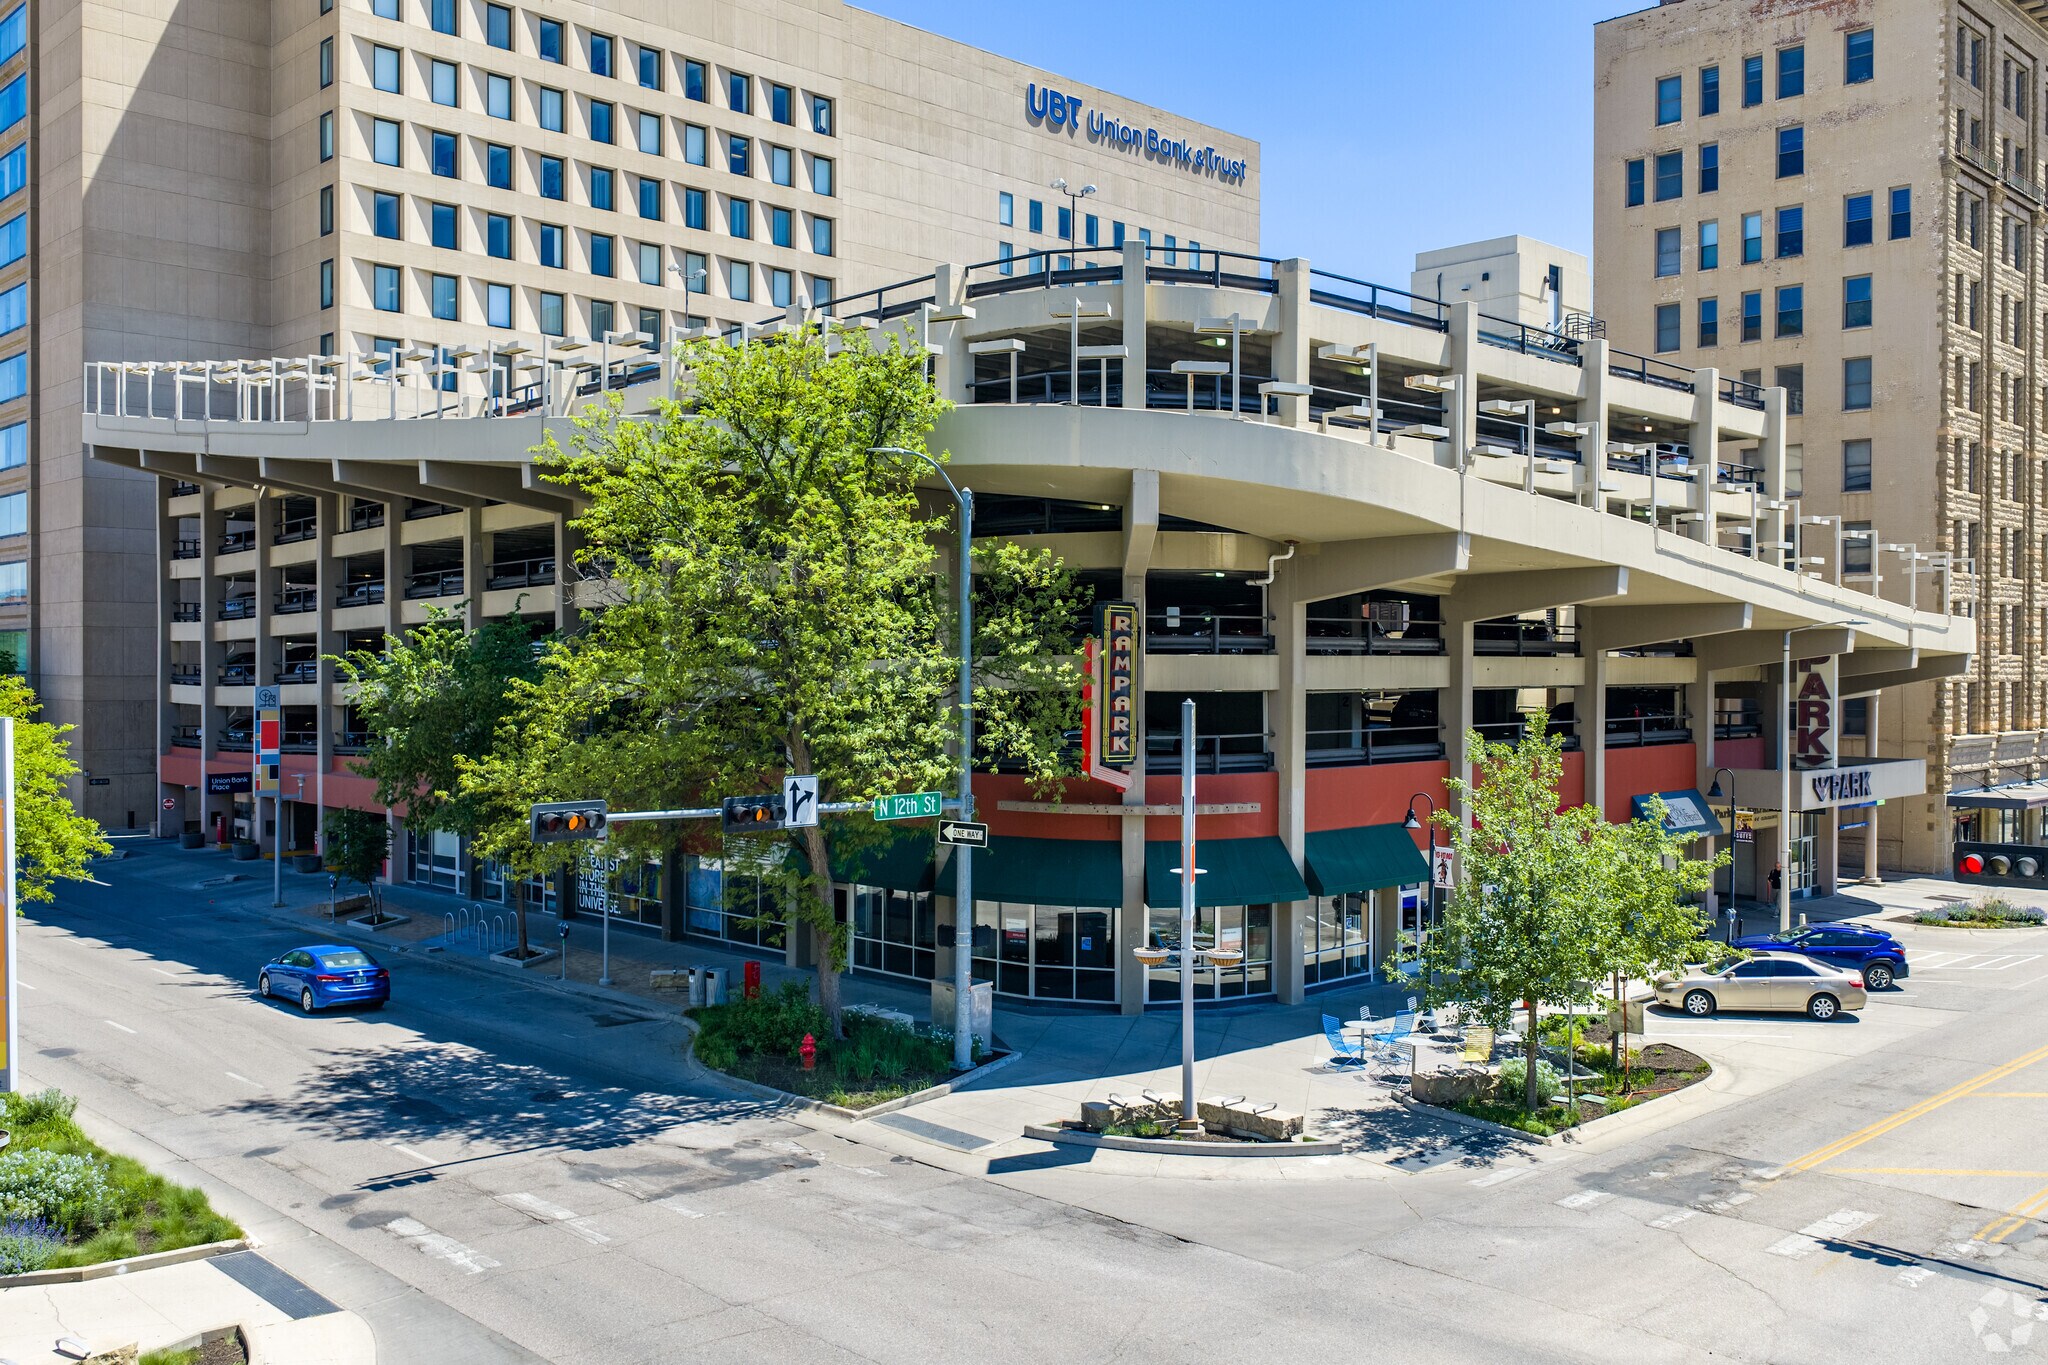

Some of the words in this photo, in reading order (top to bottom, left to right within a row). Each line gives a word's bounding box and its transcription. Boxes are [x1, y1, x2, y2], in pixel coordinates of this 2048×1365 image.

[1029, 83, 1082, 129] UBT
[1090, 109, 1142, 148] Union
[1146, 128, 1192, 164] Bank
[880, 799, 888, 817] N
[895, 797, 918, 816] 12th
[924, 796, 936, 813] St
[953, 829, 965, 838] ONE
[966, 830, 979, 839] WAY
[579, 856, 620, 872] GEATST
[579, 880, 588, 894] IN
[589, 881, 605, 898] THE
[579, 894, 621, 914] UNIVESE.
